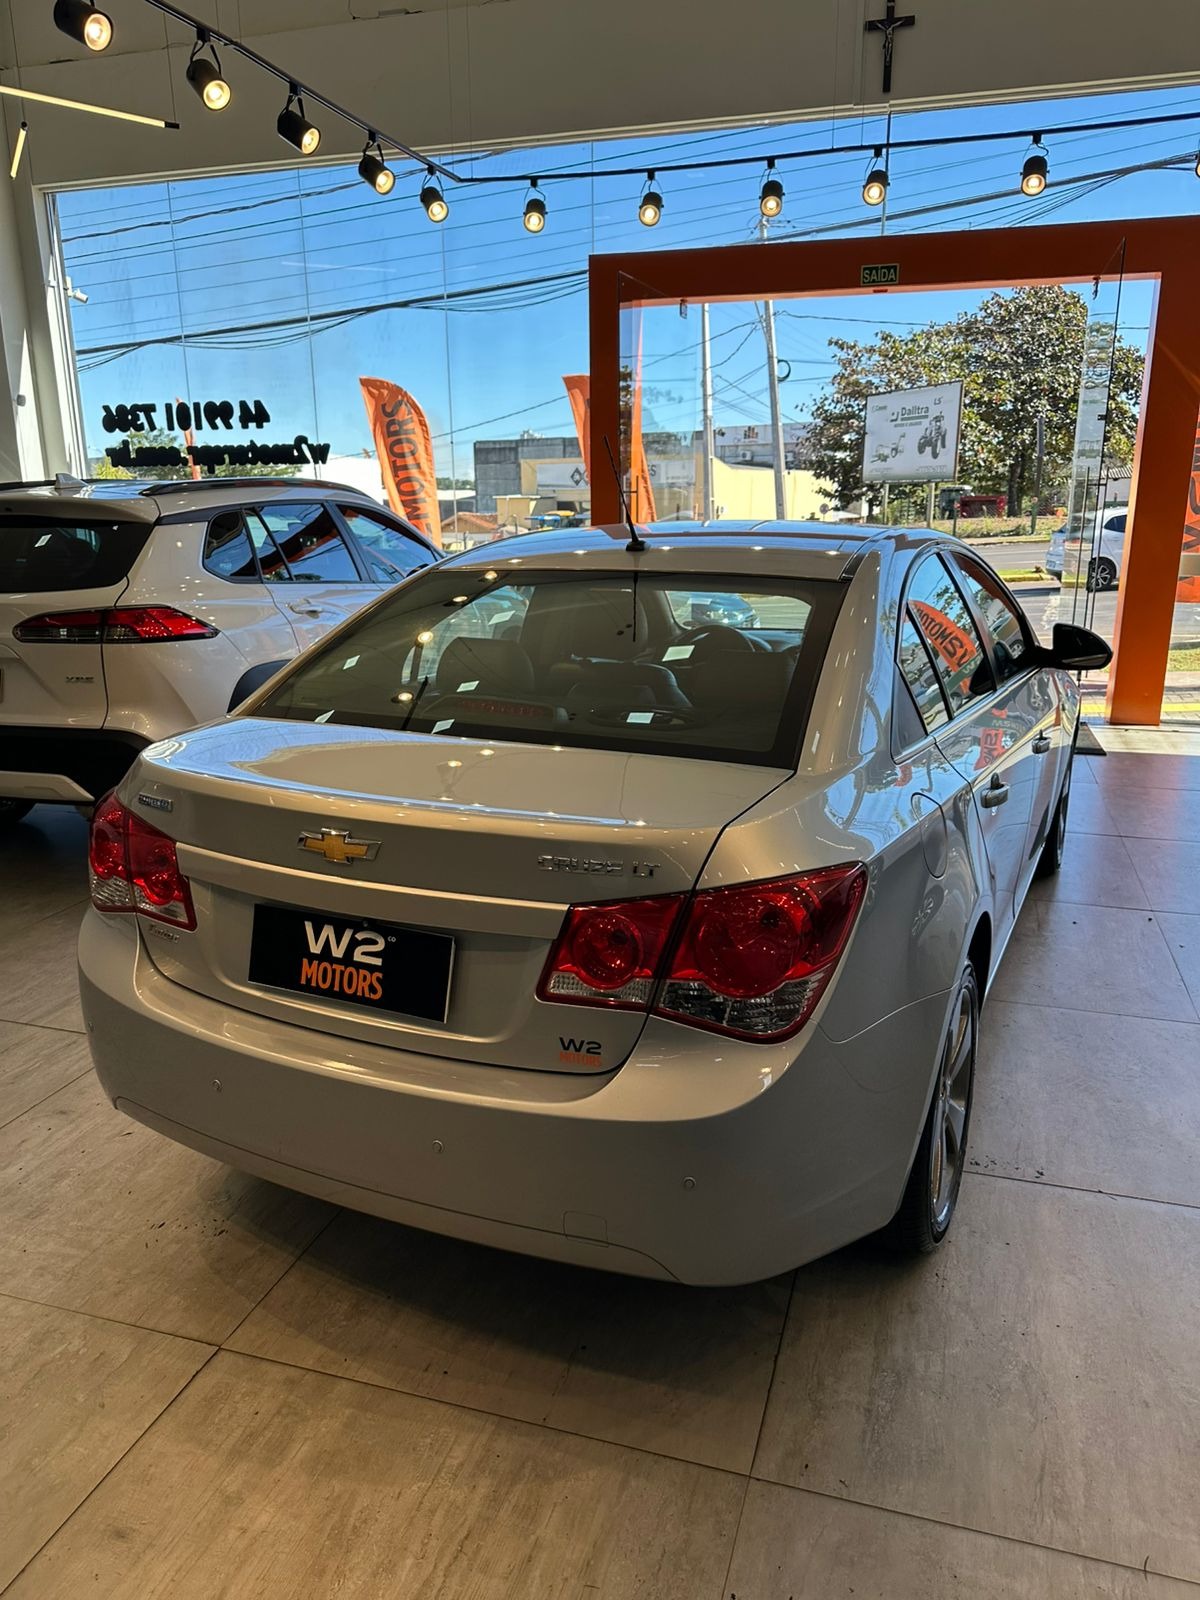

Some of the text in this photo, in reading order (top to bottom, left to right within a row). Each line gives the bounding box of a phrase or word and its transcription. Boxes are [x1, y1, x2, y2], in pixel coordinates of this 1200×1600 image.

[863, 266, 897, 283] SAÍDA
[381, 395, 430, 521] MOTORS
[537, 855, 662, 879] CRUZE LT
[304, 920, 386, 966] W2
[300, 957, 384, 1001] MOTORS
[559, 1036, 602, 1056] W2
